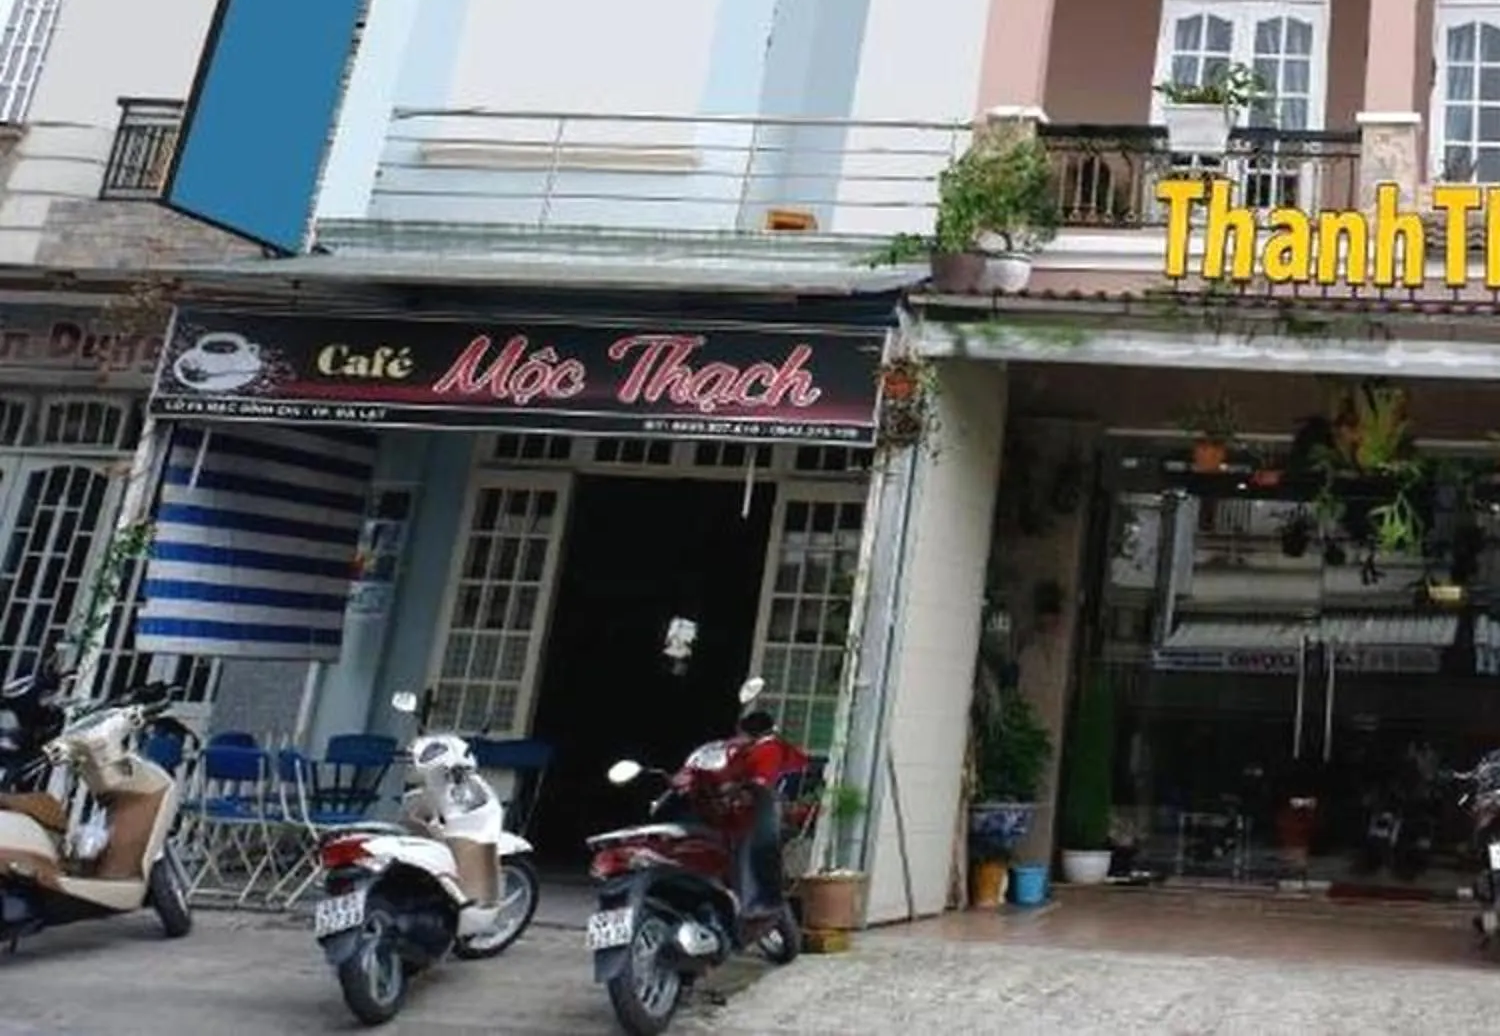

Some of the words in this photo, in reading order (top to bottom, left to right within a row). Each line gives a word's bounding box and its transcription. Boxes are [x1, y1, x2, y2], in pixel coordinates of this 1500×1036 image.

[316, 344, 413, 380] Café
[432, 334, 587, 405] Mộc
[608, 333, 823, 412] Thạch
